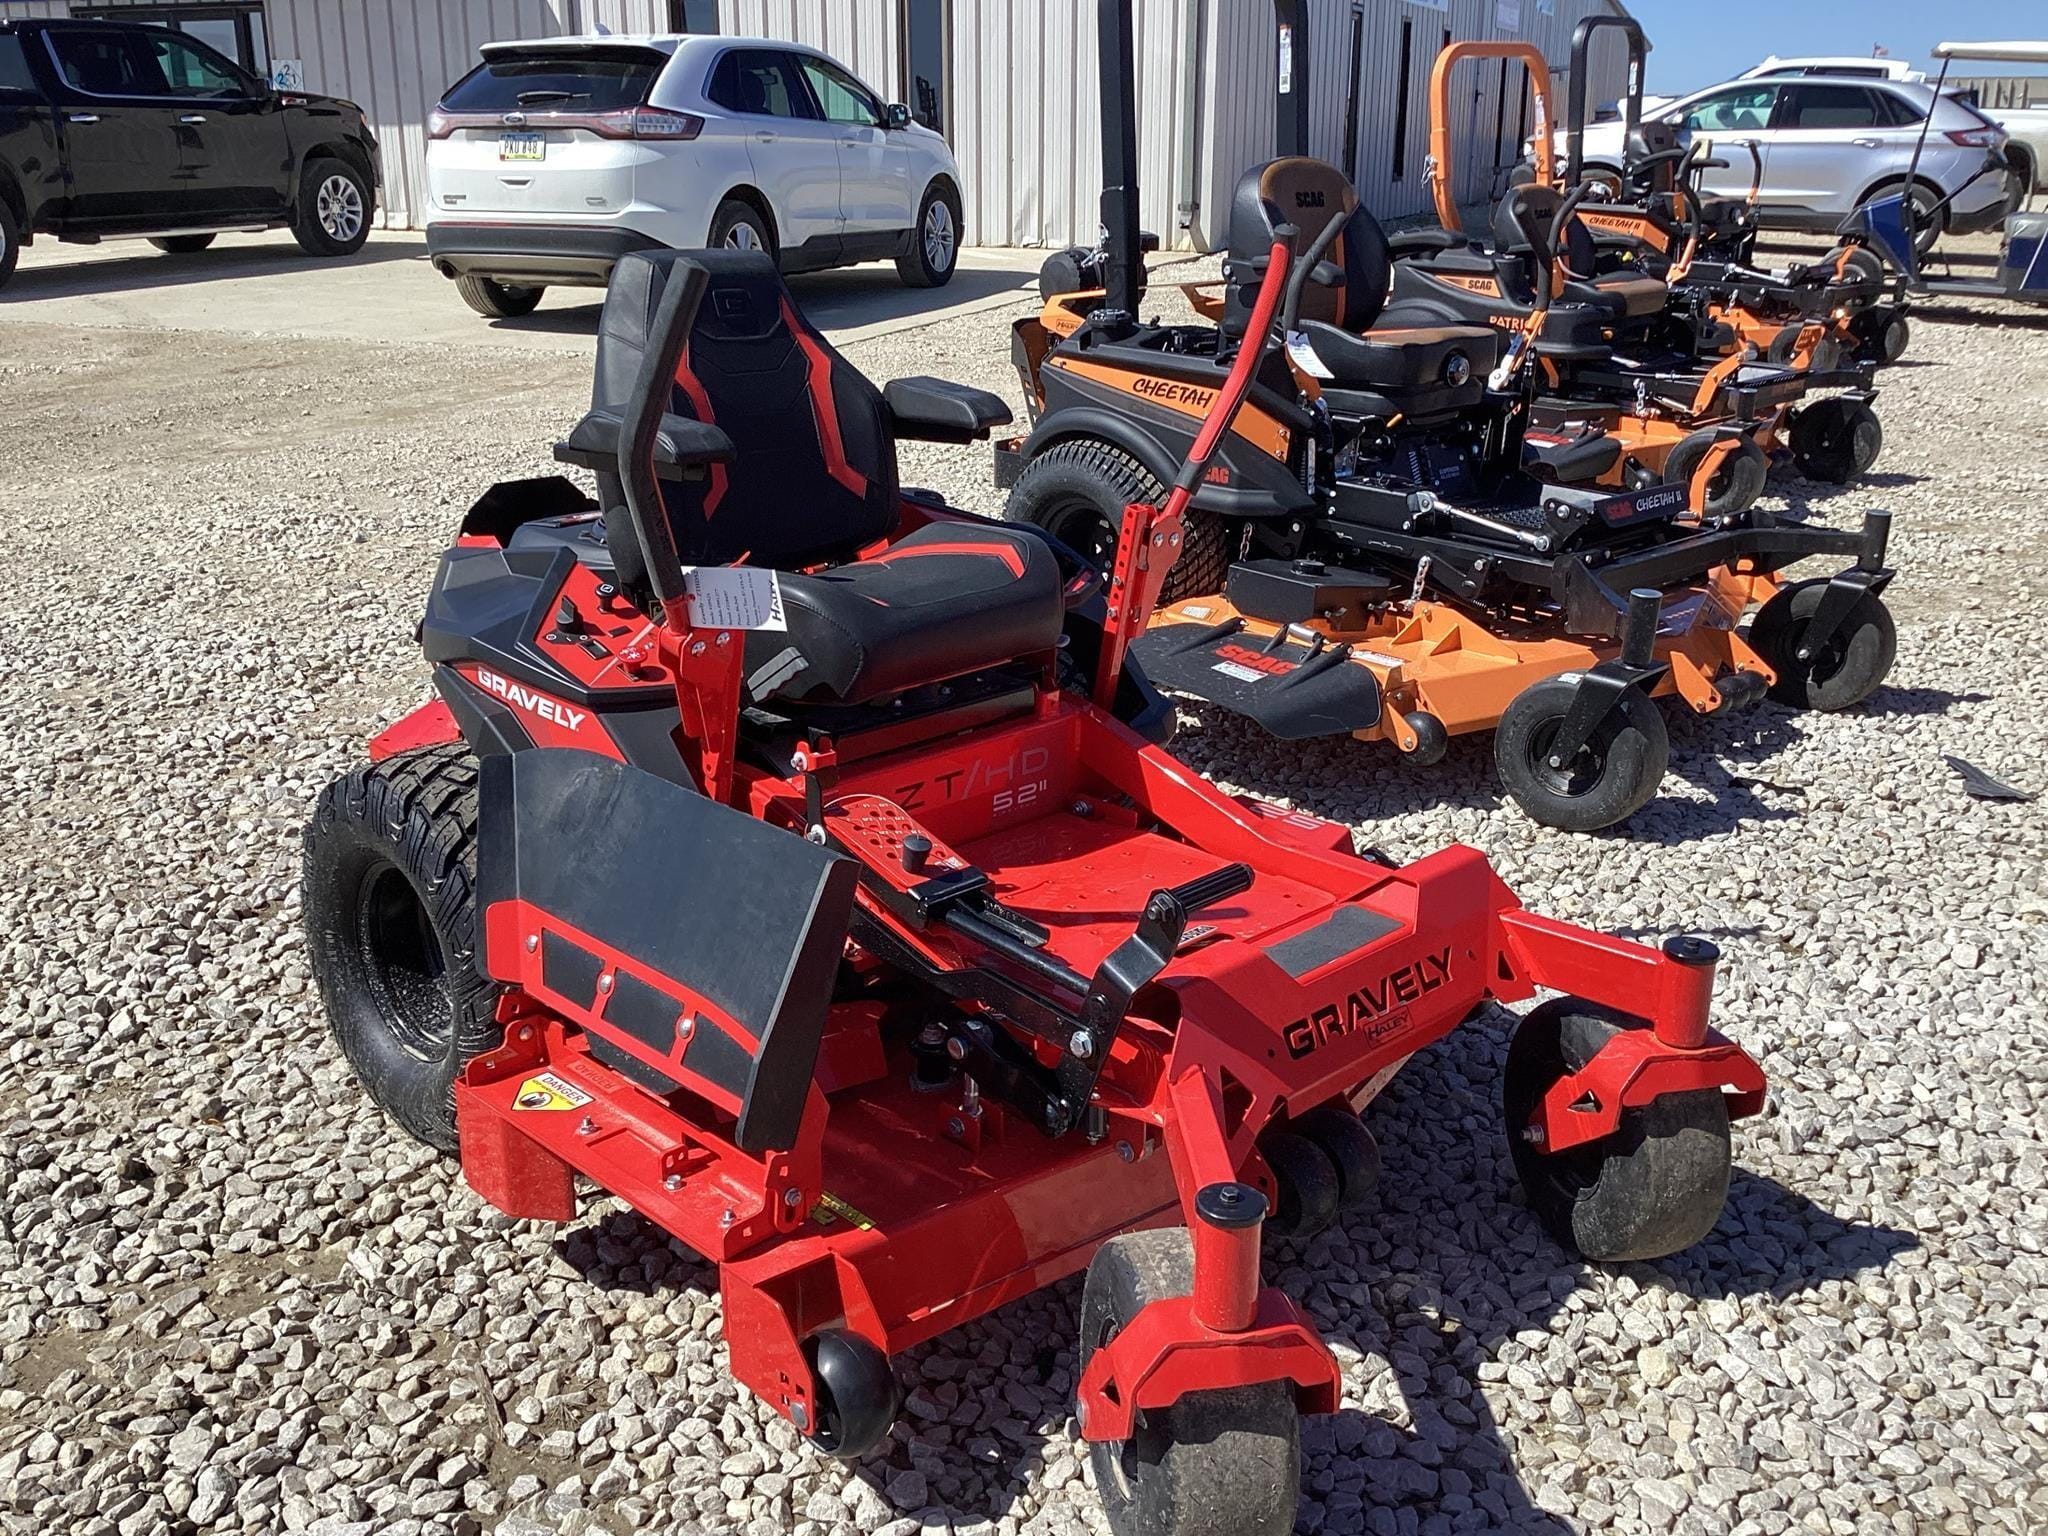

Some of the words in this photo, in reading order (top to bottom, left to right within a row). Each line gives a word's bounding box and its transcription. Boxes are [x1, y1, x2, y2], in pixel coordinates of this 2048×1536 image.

[278, 73, 284, 85] 2
[284, 64, 290, 76] 2
[1295, 191, 1325, 208] SCAG
[1589, 216, 1633, 228] CHEETAH
[1467, 279, 1493, 291] SCAG
[1132, 378, 1214, 408] CHEETAH
[1636, 491, 1675, 512] CHEETAH
[1215, 644, 1297, 676] SCAG
[477, 666, 586, 731] GRAVELY
[895, 747, 1049, 812] ZT/HD
[1282, 946, 1453, 1061] GRAVELY
[1367, 1013, 1410, 1041] HALEY
[541, 1076, 585, 1102] DANGER
